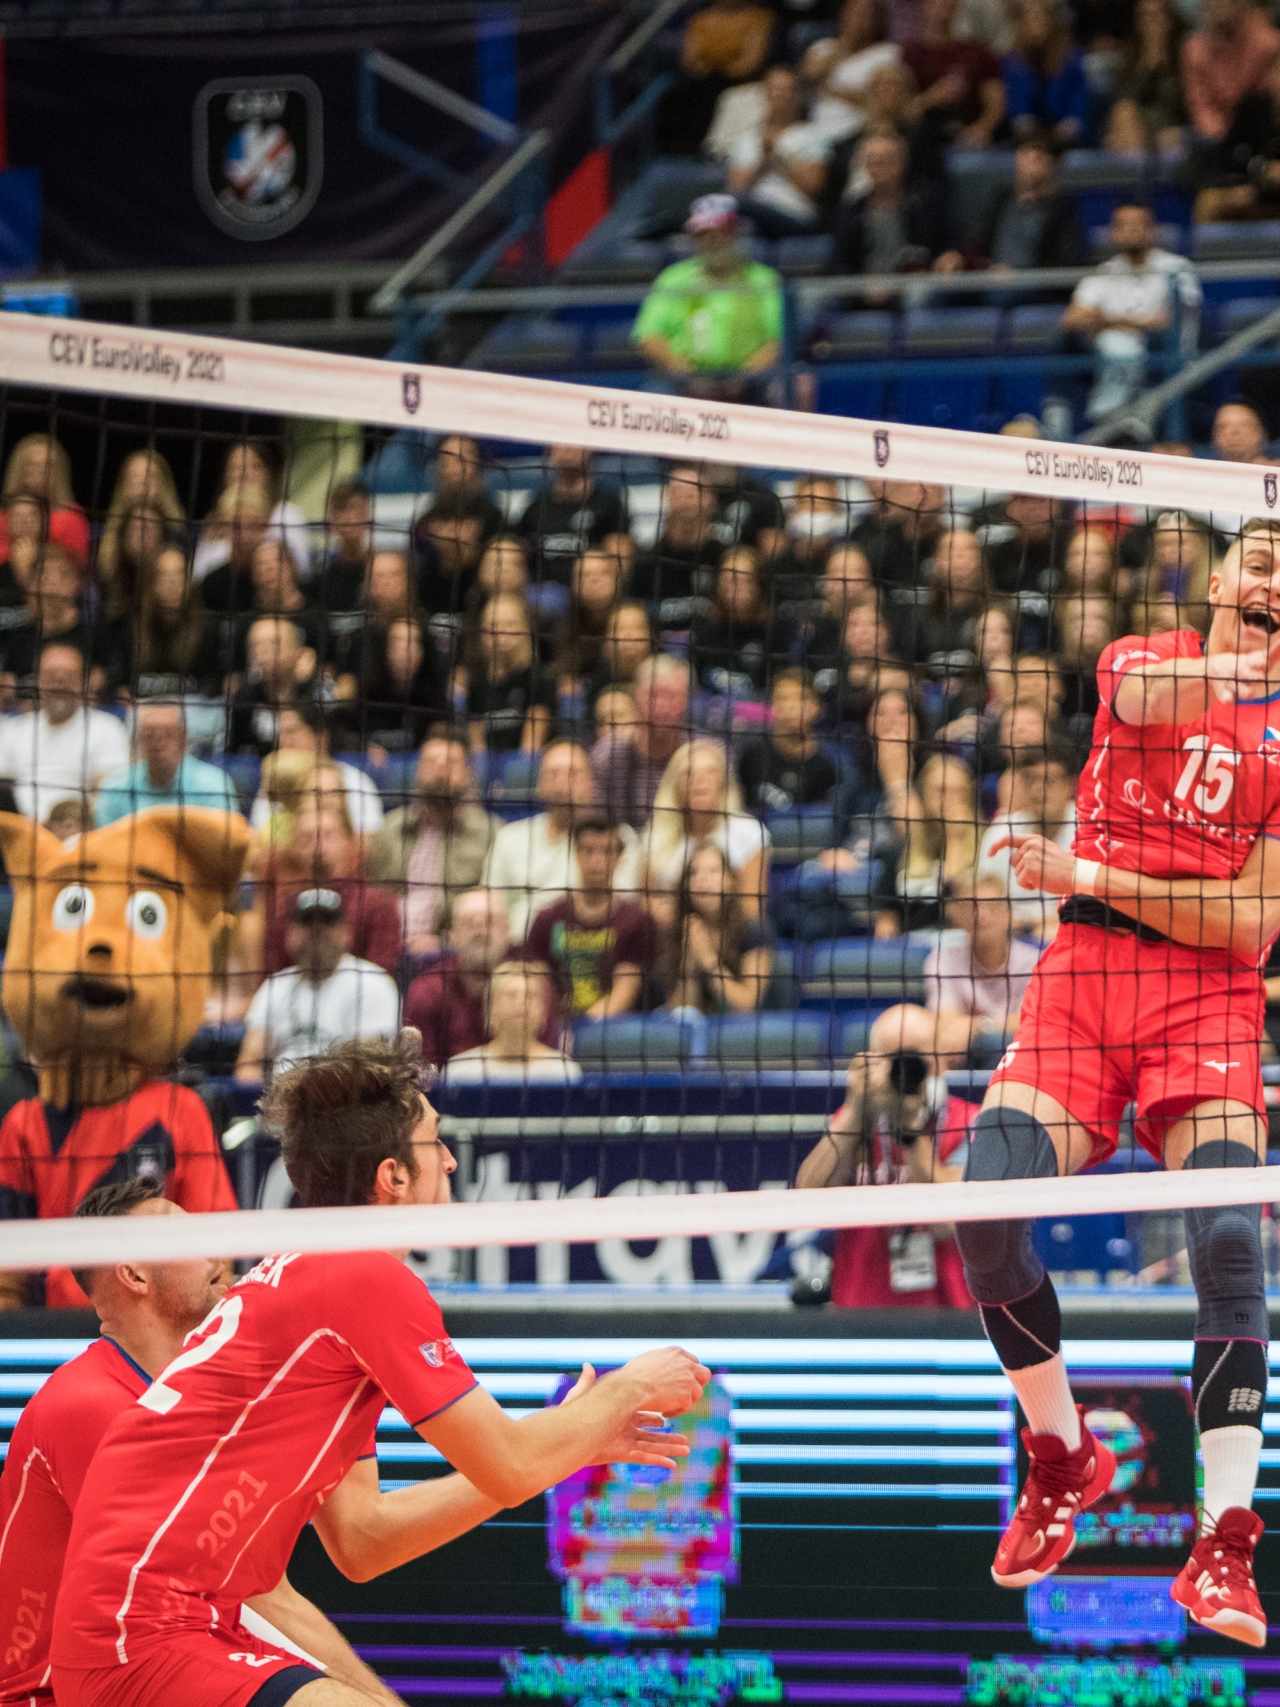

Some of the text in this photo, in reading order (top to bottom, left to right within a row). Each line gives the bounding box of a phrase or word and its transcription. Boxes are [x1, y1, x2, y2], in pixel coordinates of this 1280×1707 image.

[50, 332, 87, 366] CEV
[91, 337, 181, 386] EuroVolley
[587, 400, 730, 440] CEV EuroVolley 2021
[1025, 450, 1144, 488] CEV EuroVolley 2021
[1173, 733, 1243, 815] 15
[197, 1470, 268, 1558] 2021
[5, 1586, 48, 1671] 2021
